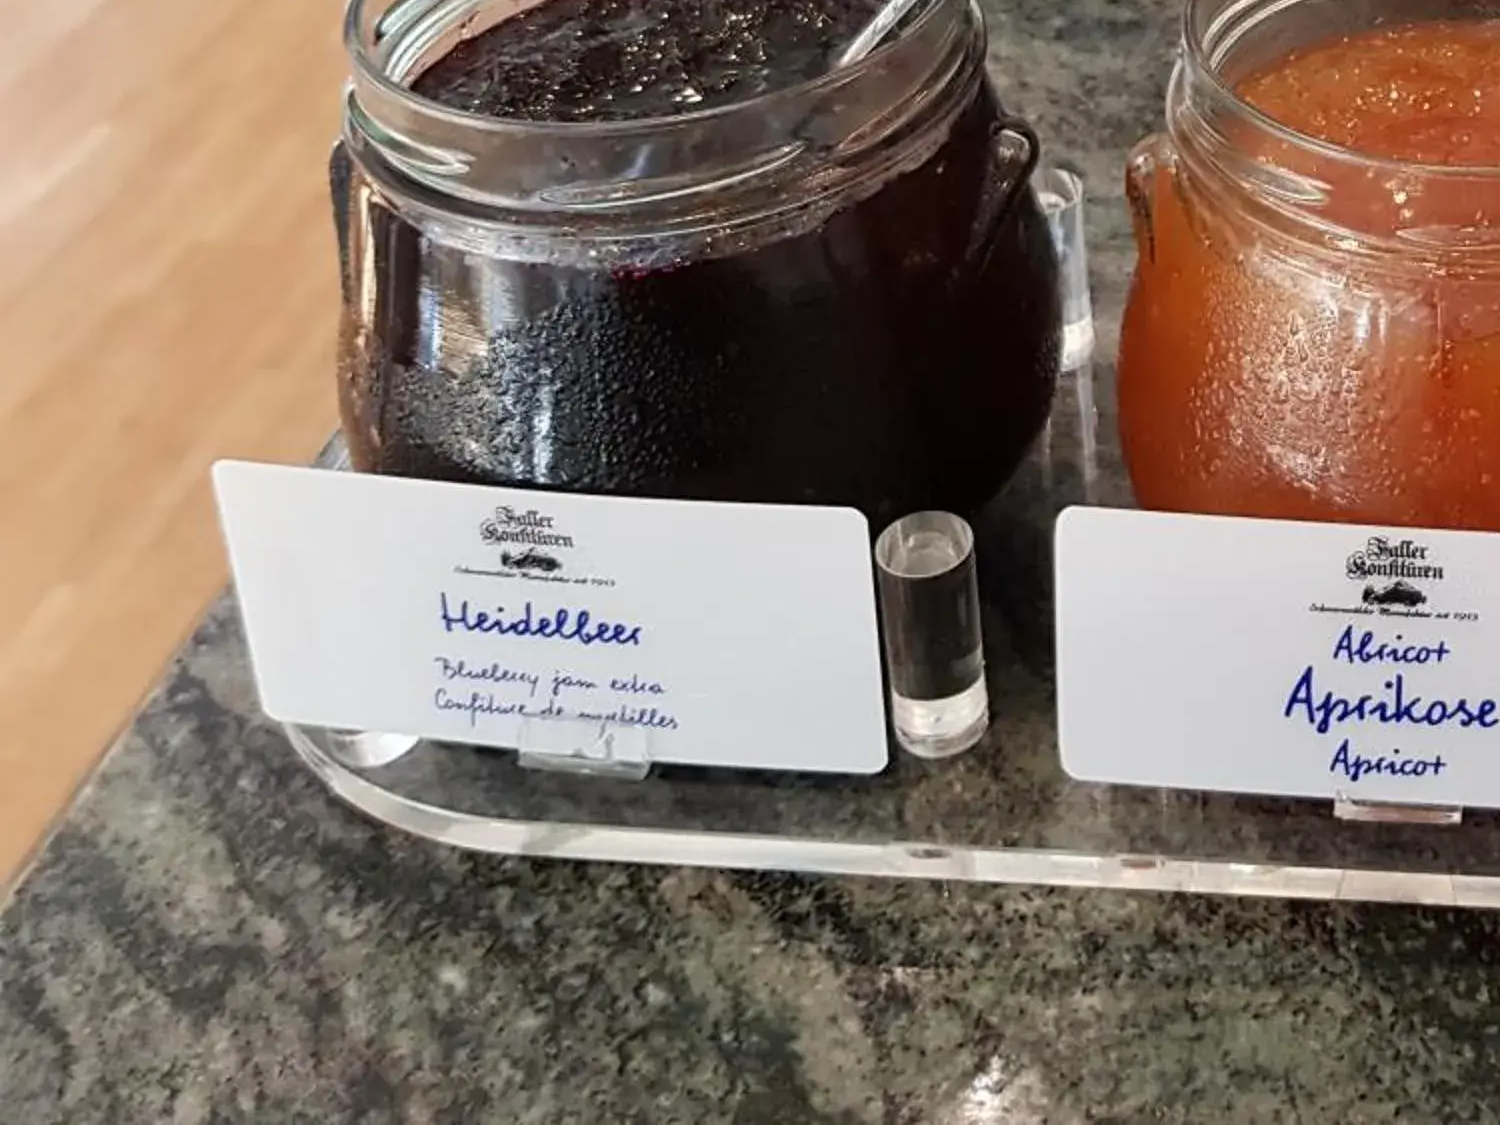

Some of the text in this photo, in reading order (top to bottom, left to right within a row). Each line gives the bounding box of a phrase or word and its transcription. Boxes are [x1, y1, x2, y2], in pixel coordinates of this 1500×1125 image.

[1366, 536, 1429, 561] Faller
[440, 591, 643, 647] Heidelbeer
[1332, 623, 1452, 665] Abricot
[433, 656, 666, 699] Blueberry jam extra
[434, 687, 528, 728] Confiture
[1283, 665, 1500, 735] Aprikose
[1329, 737, 1448, 783] Apricot
